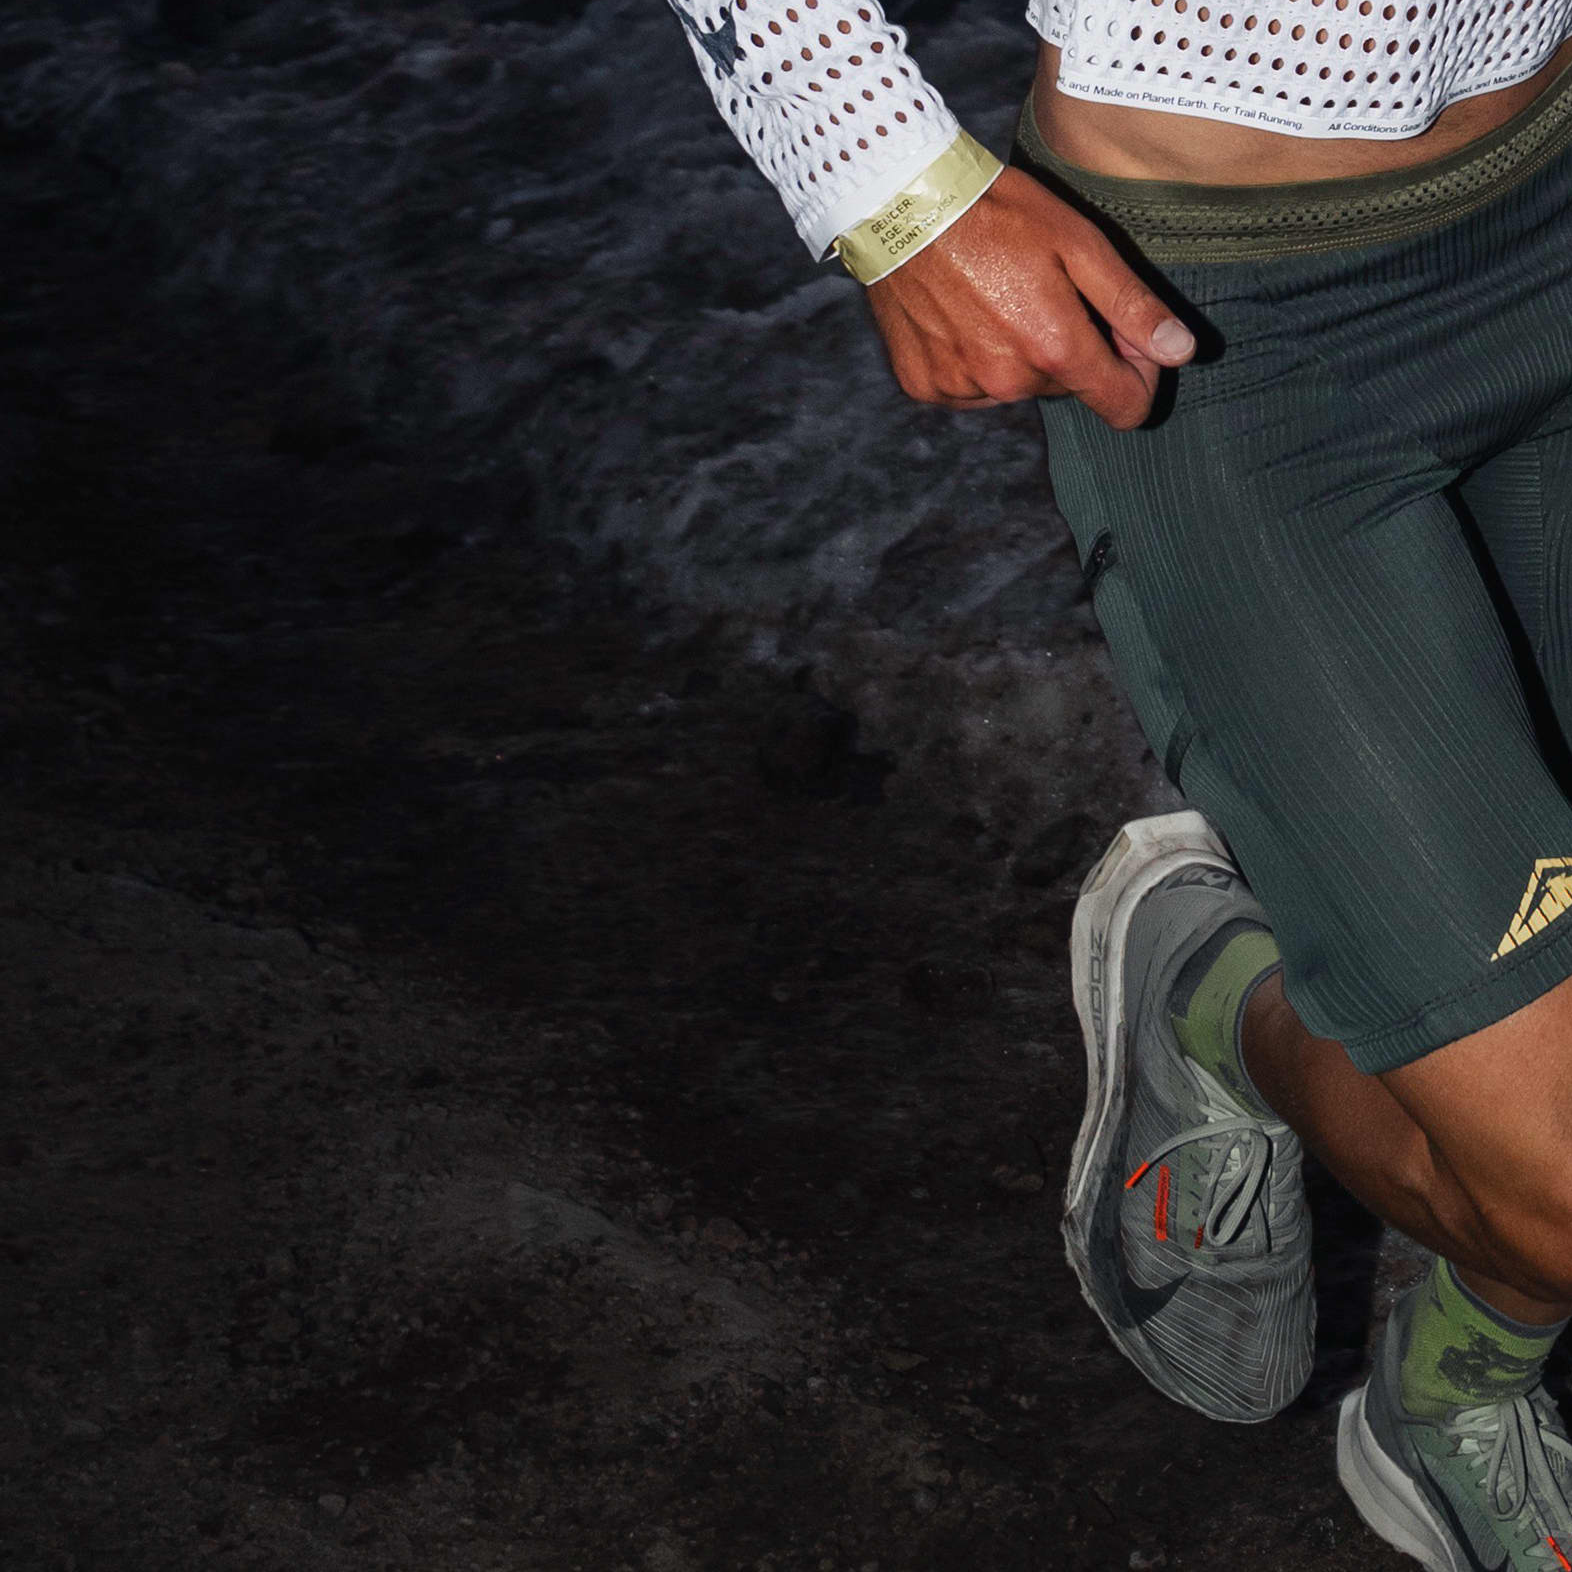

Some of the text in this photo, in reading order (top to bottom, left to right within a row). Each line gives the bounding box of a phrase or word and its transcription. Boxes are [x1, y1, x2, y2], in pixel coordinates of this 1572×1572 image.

[1068, 81, 1090, 93] and
[1093, 86, 1124, 98] Made
[1126, 92, 1140, 100] on
[1142, 92, 1175, 105] Planet
[1177, 97, 1209, 109] Earth.
[1213, 102, 1230, 113] For
[1234, 106, 1257, 118] Trail
[1328, 123, 1341, 131] All
[1343, 122, 1398, 134] Conditions
